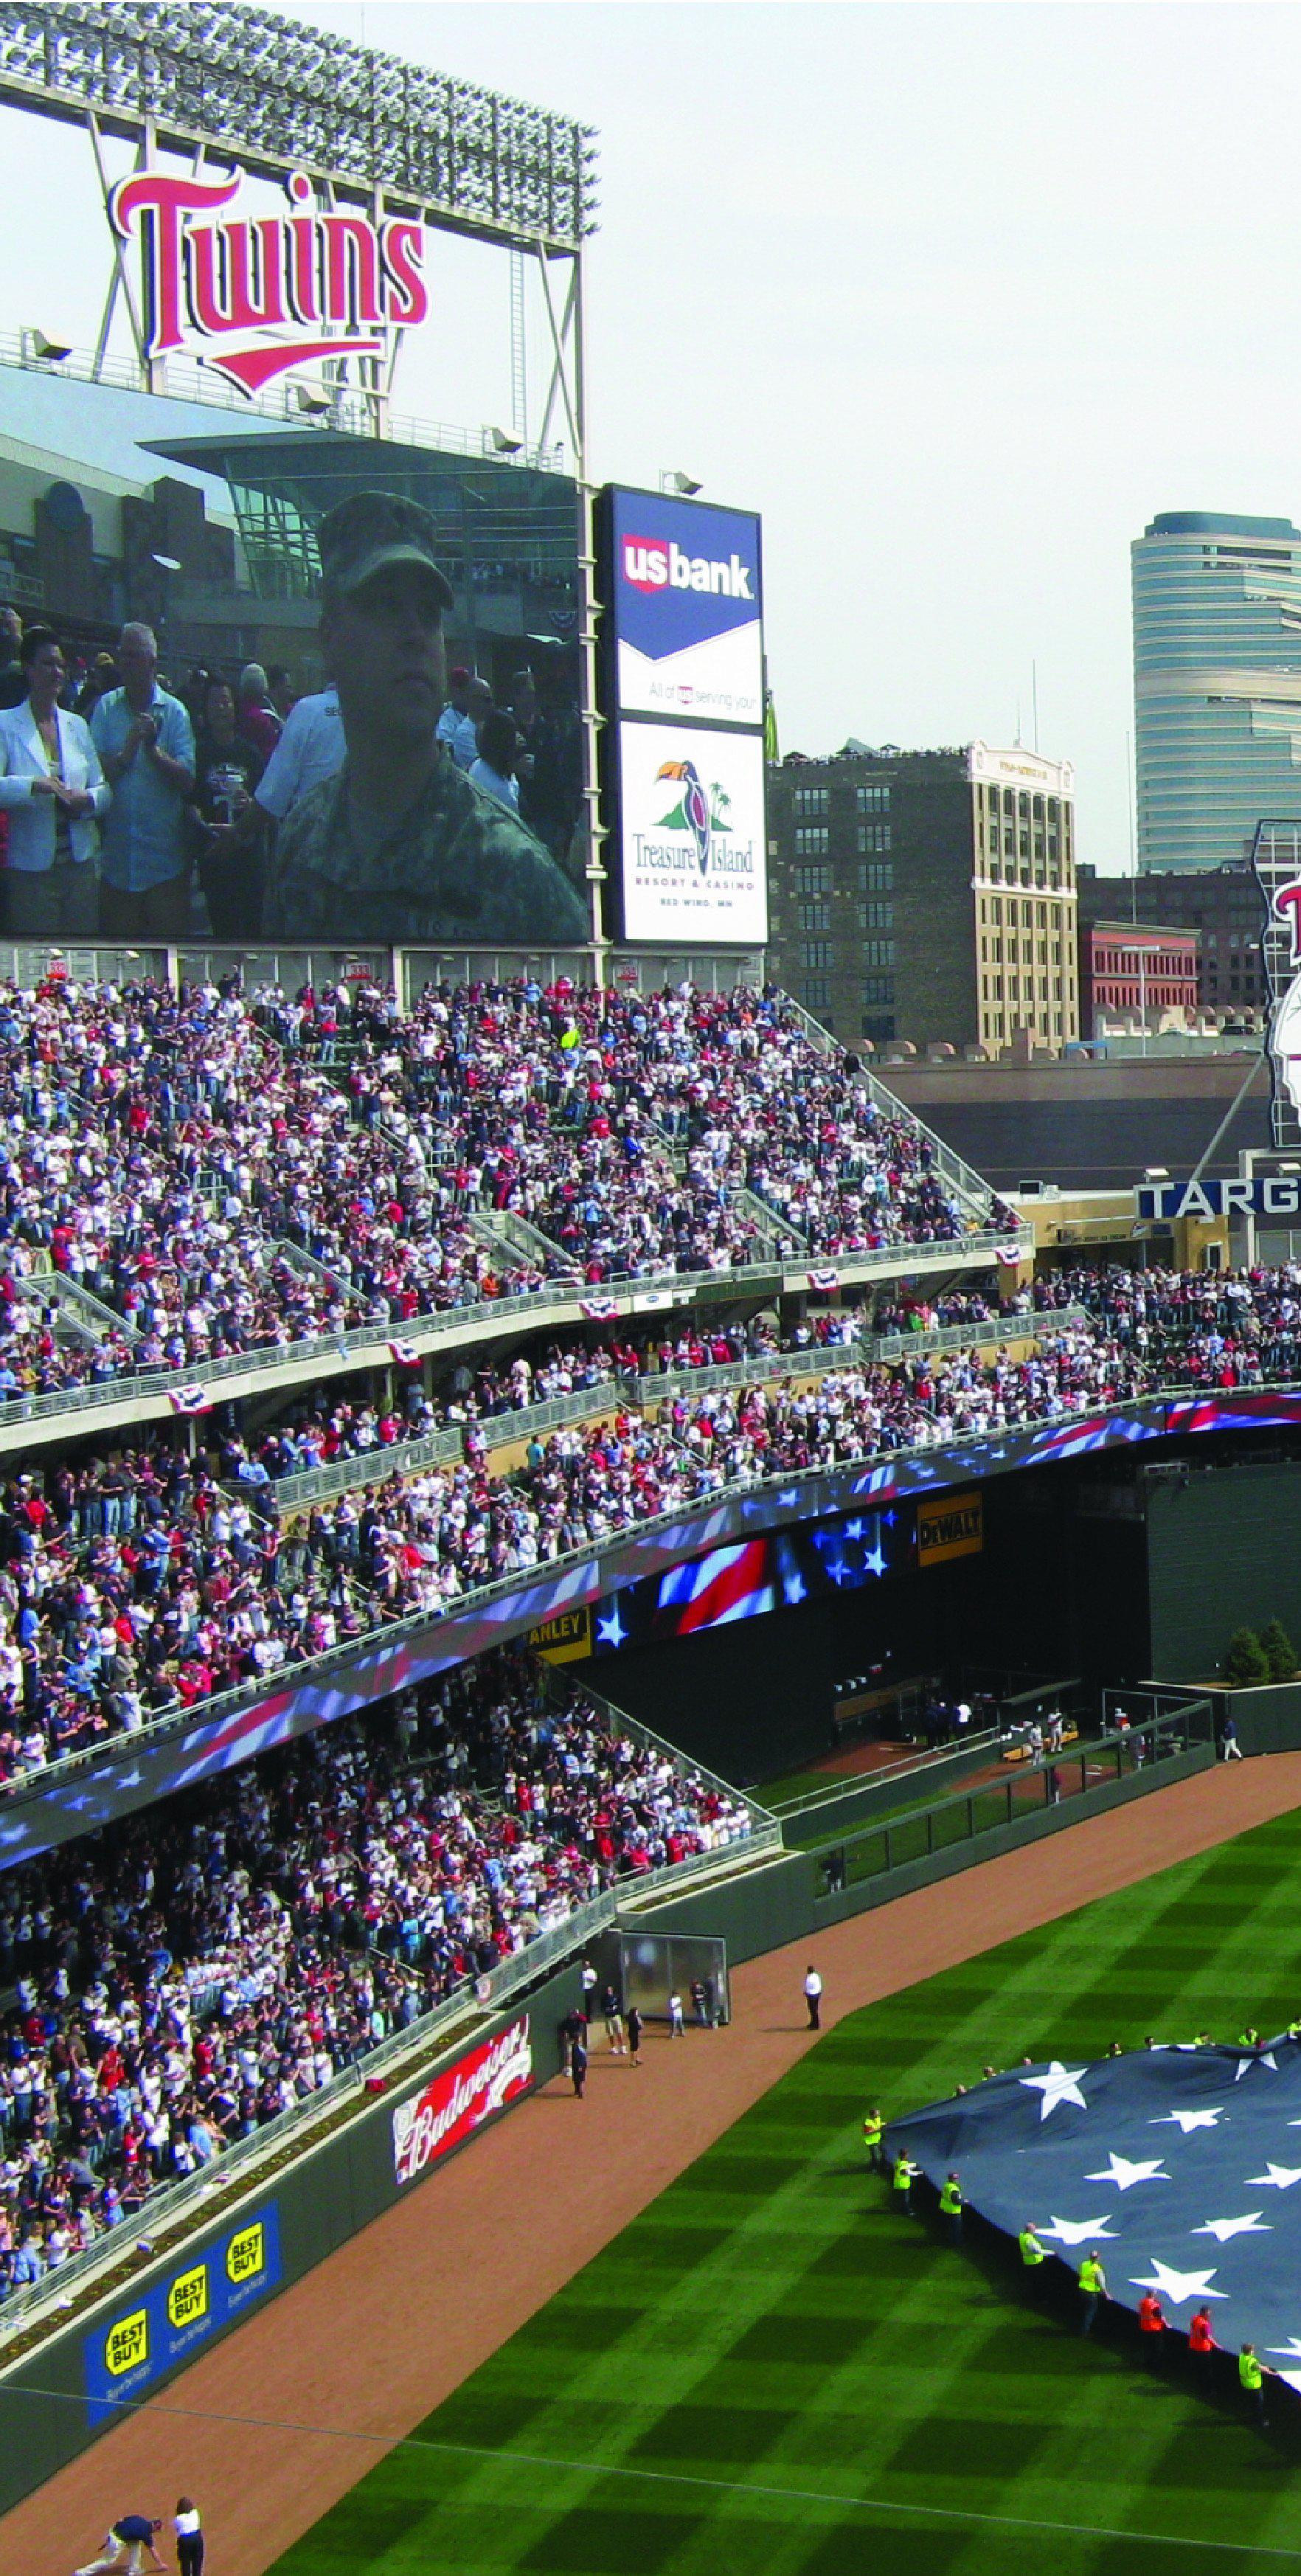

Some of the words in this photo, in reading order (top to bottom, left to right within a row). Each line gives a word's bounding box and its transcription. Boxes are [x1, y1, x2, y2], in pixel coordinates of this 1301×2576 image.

[108, 164, 432, 360] Twins
[632, 833, 695, 870] Treasure
[711, 838, 754, 873] Island
[635, 877, 685, 887] RESORT
[706, 880, 754, 890] CASINO
[1134, 1177, 1299, 1219] TARG
[401, 2012, 530, 2178] Budweiser
[232, 2234, 260, 2259] BEST
[234, 2252, 257, 2274] BUY
[174, 2276, 204, 2302] BEST
[176, 2294, 201, 2318] BUY
[111, 2321, 144, 2351] BEST
[114, 2342, 141, 2366] BUY
